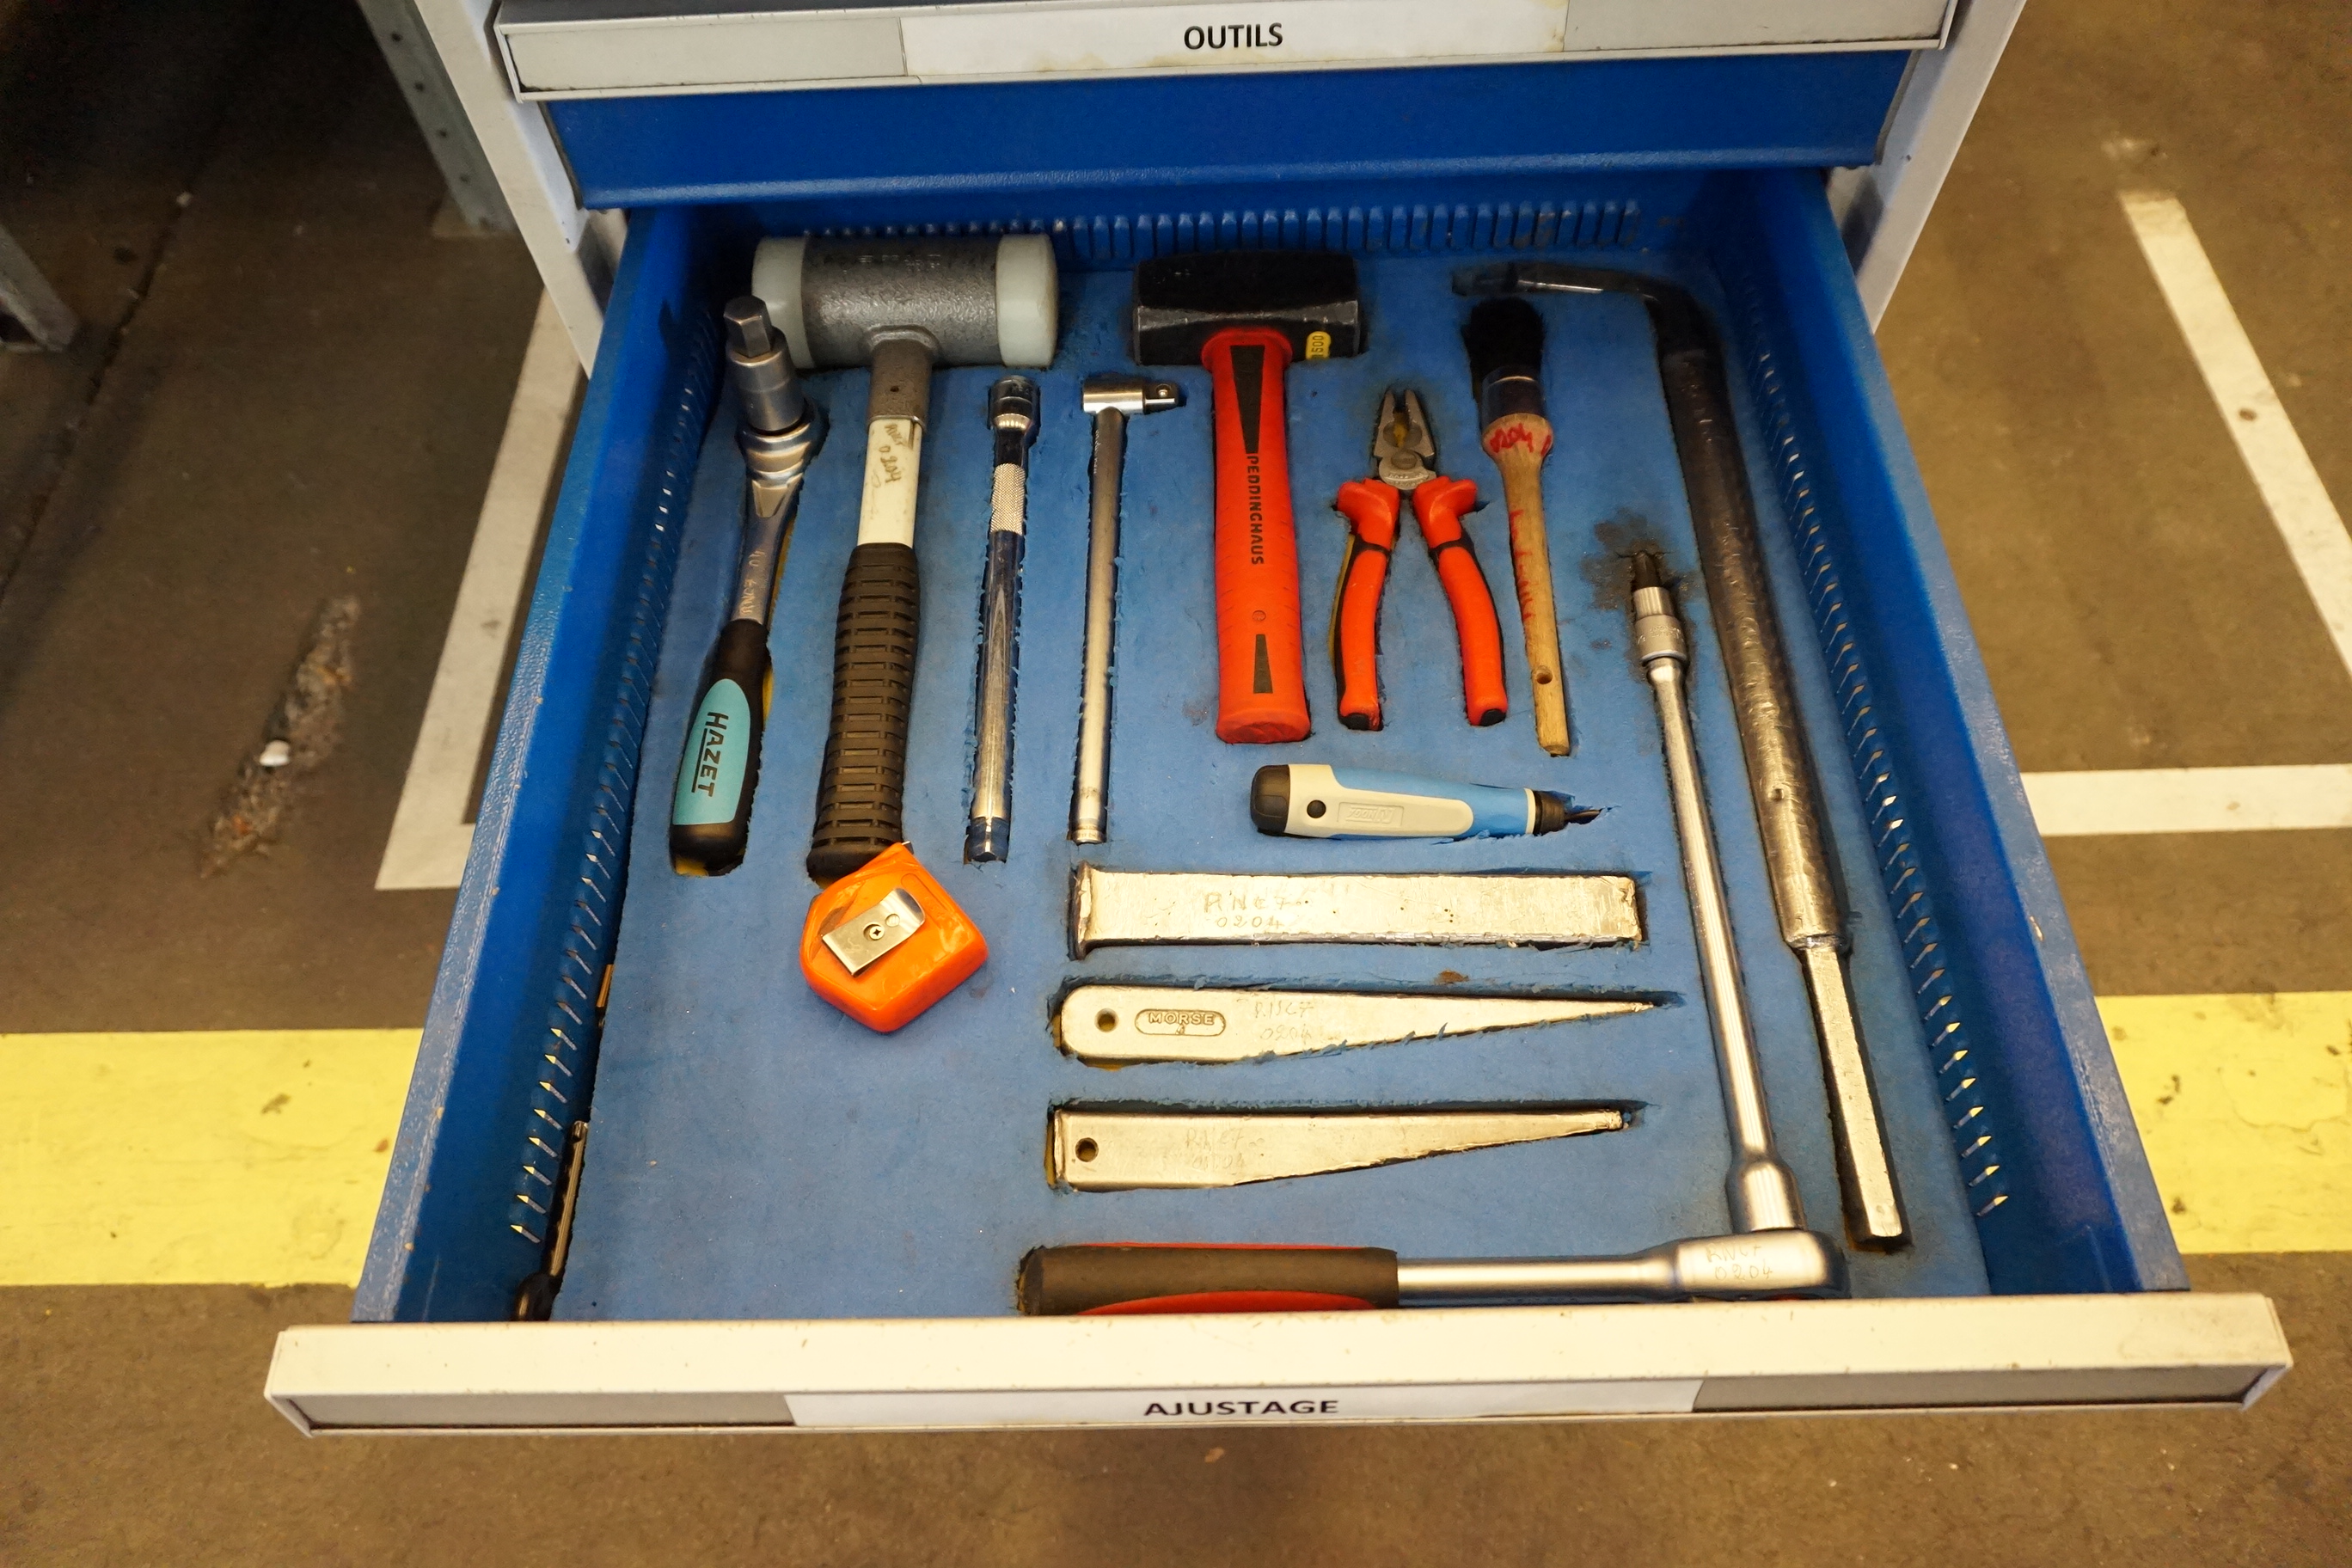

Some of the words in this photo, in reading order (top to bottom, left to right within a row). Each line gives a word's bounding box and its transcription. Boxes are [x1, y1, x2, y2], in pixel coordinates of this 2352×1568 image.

[1184, 22, 1283, 50] OUTILS
[1246, 455, 1265, 565] PEDDINGHAUS
[698, 712, 729, 797] HAZET
[1216, 916, 1284, 929] 0204
[1148, 1012, 1215, 1026] MORSE
[1715, 1259, 1773, 1280] 0204
[1143, 1400, 1339, 1416] AJUSTAGE
